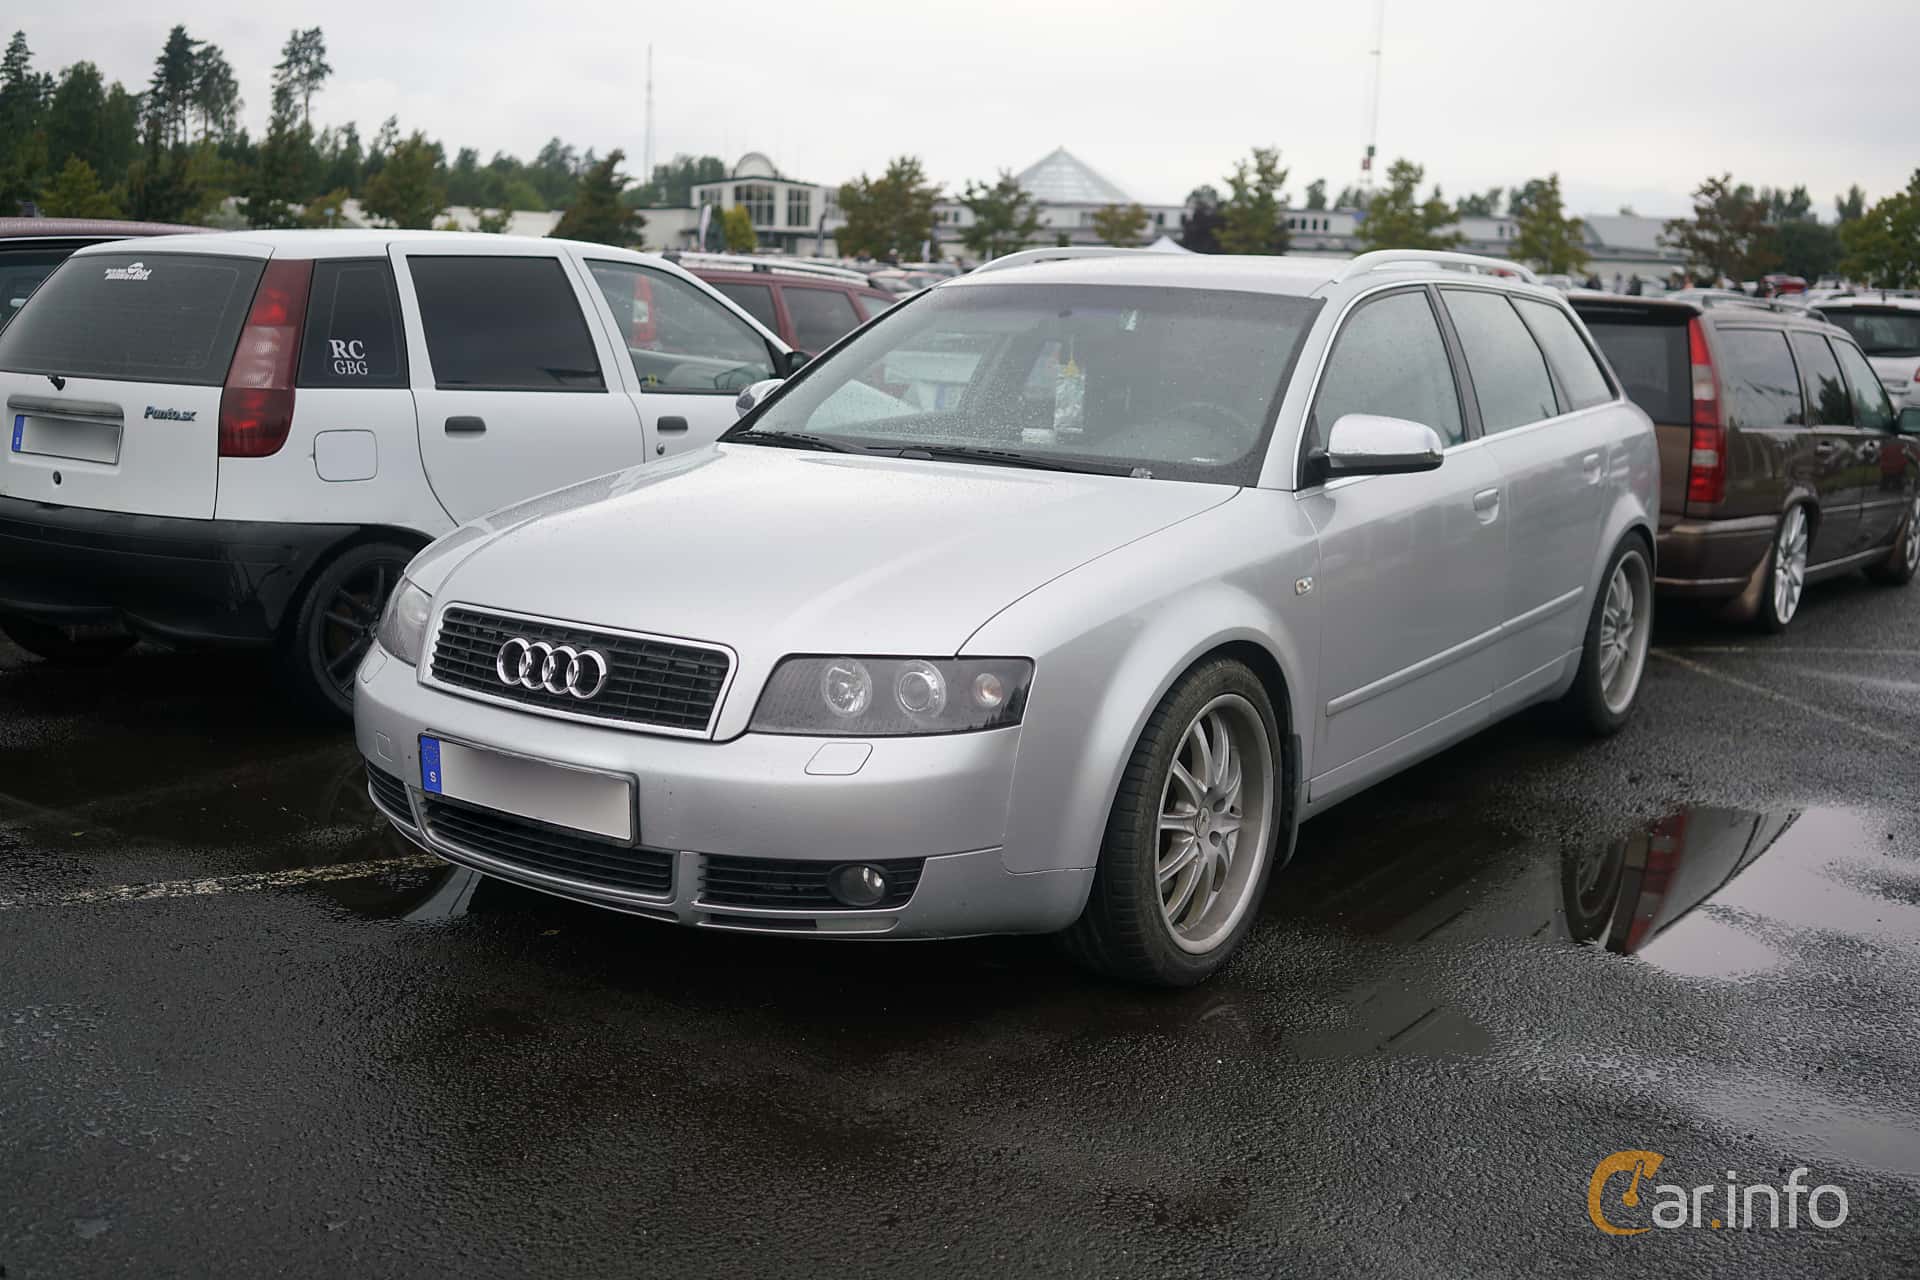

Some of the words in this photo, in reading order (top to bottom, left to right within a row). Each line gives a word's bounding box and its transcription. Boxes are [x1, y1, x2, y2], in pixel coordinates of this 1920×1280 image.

[328, 339, 366, 359] RC
[334, 360, 369, 375] GBG
[430, 771, 437, 783] S
